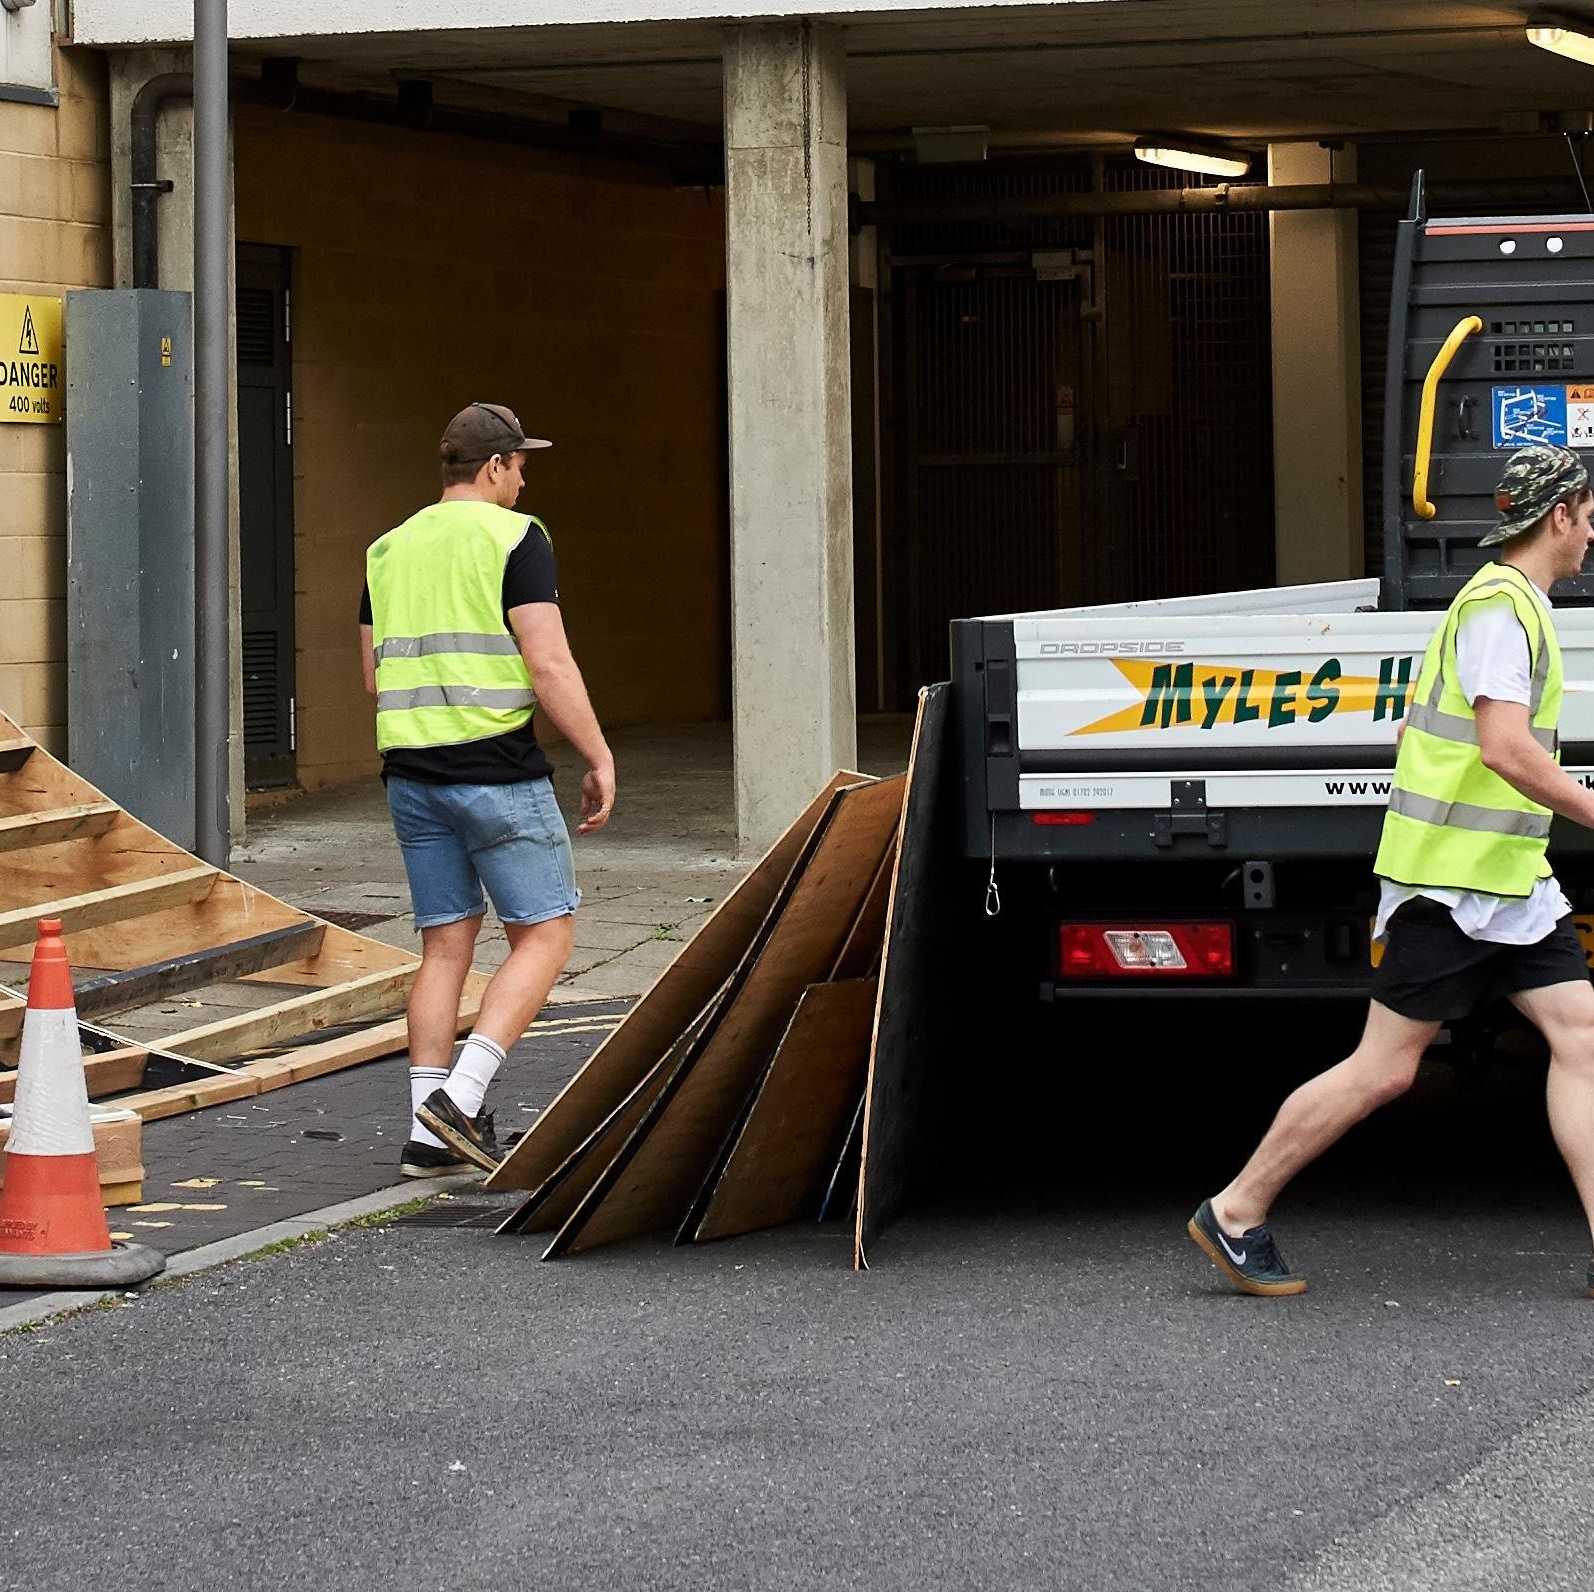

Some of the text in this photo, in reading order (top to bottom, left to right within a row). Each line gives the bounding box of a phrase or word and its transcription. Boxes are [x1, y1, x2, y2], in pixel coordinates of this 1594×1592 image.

[9, 396, 50, 413] 400 volts
[1039, 641, 1185, 655] DROPSIDE
[1139, 658, 1342, 729] MYLES
